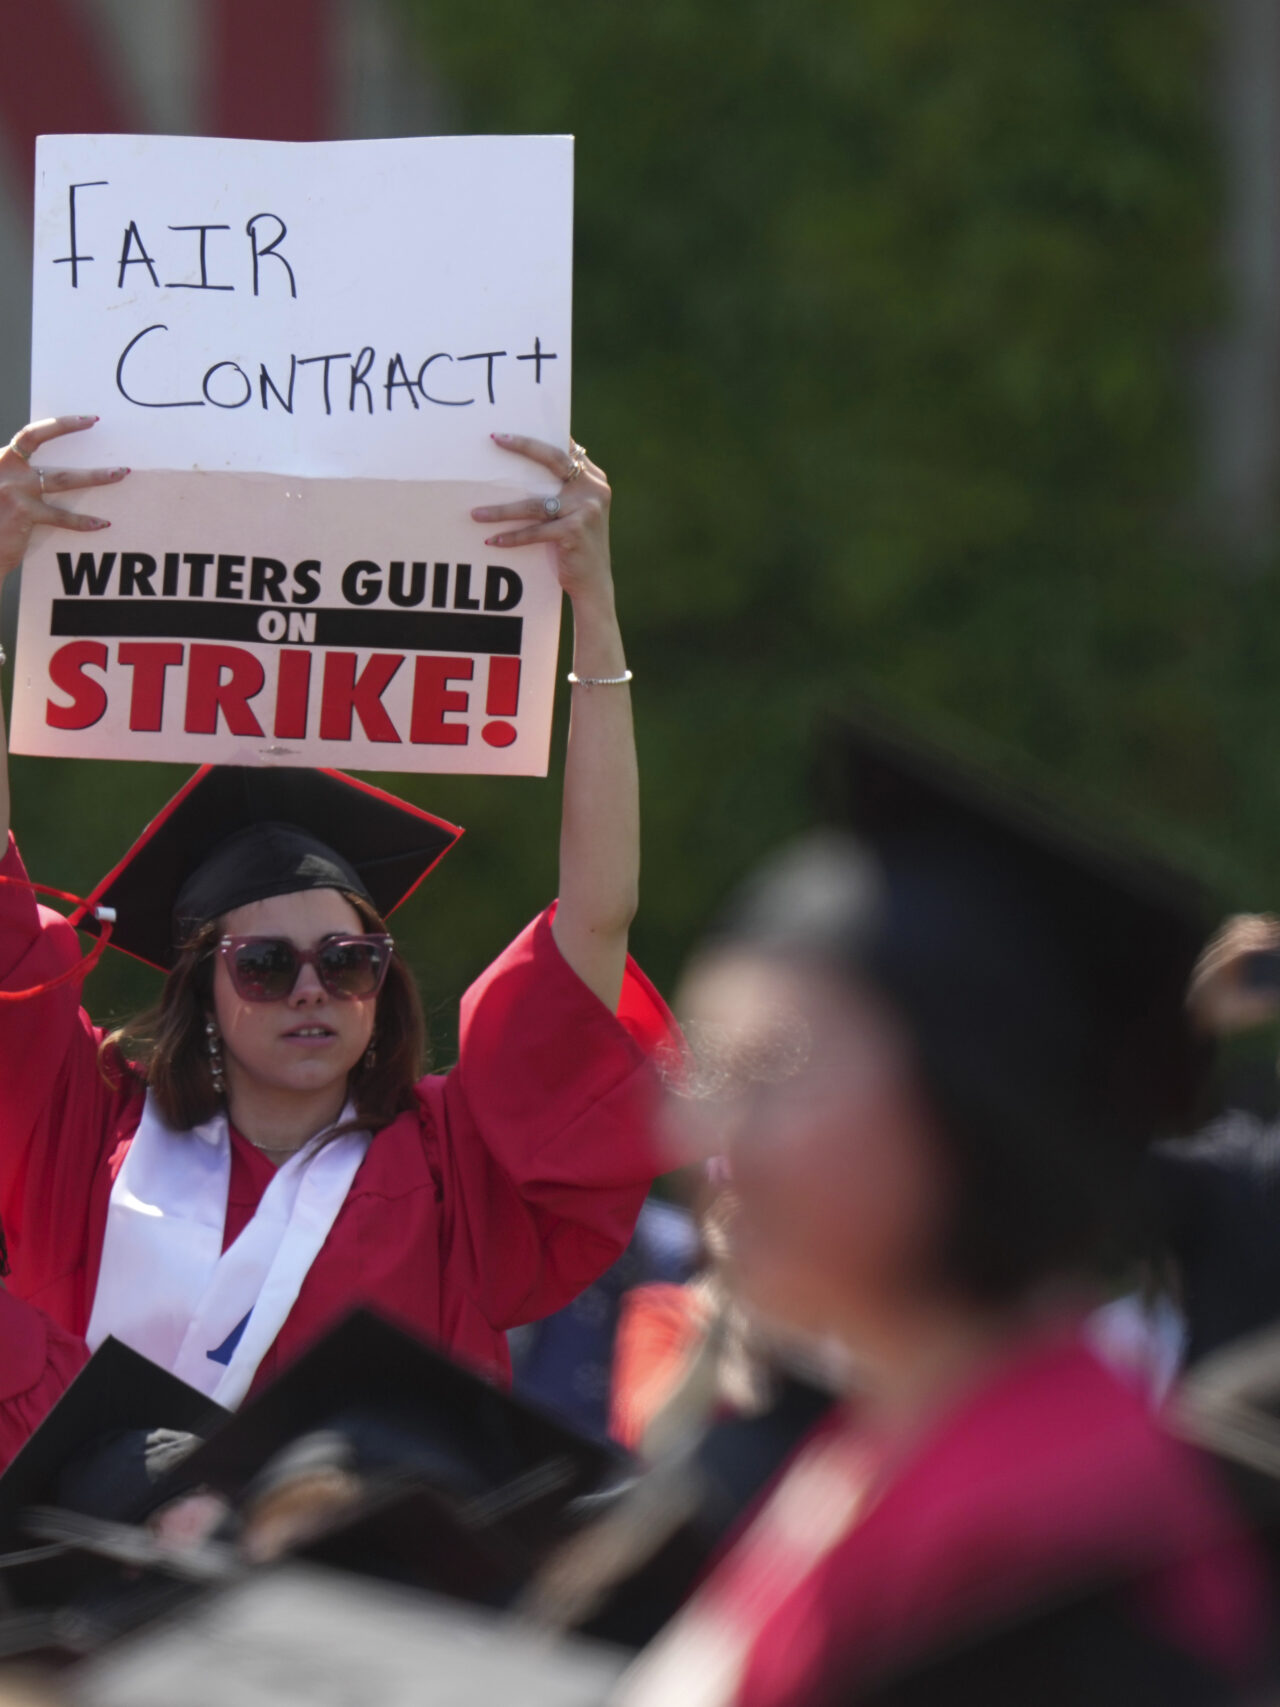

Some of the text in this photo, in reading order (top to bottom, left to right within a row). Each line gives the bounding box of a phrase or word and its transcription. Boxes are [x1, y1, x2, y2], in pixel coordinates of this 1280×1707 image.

[52, 181, 297, 299] FAIR
[56, 552, 523, 611] WRITERS GUILD
[258, 610, 316, 643] ON
[46, 640, 521, 749] STRIKE!
